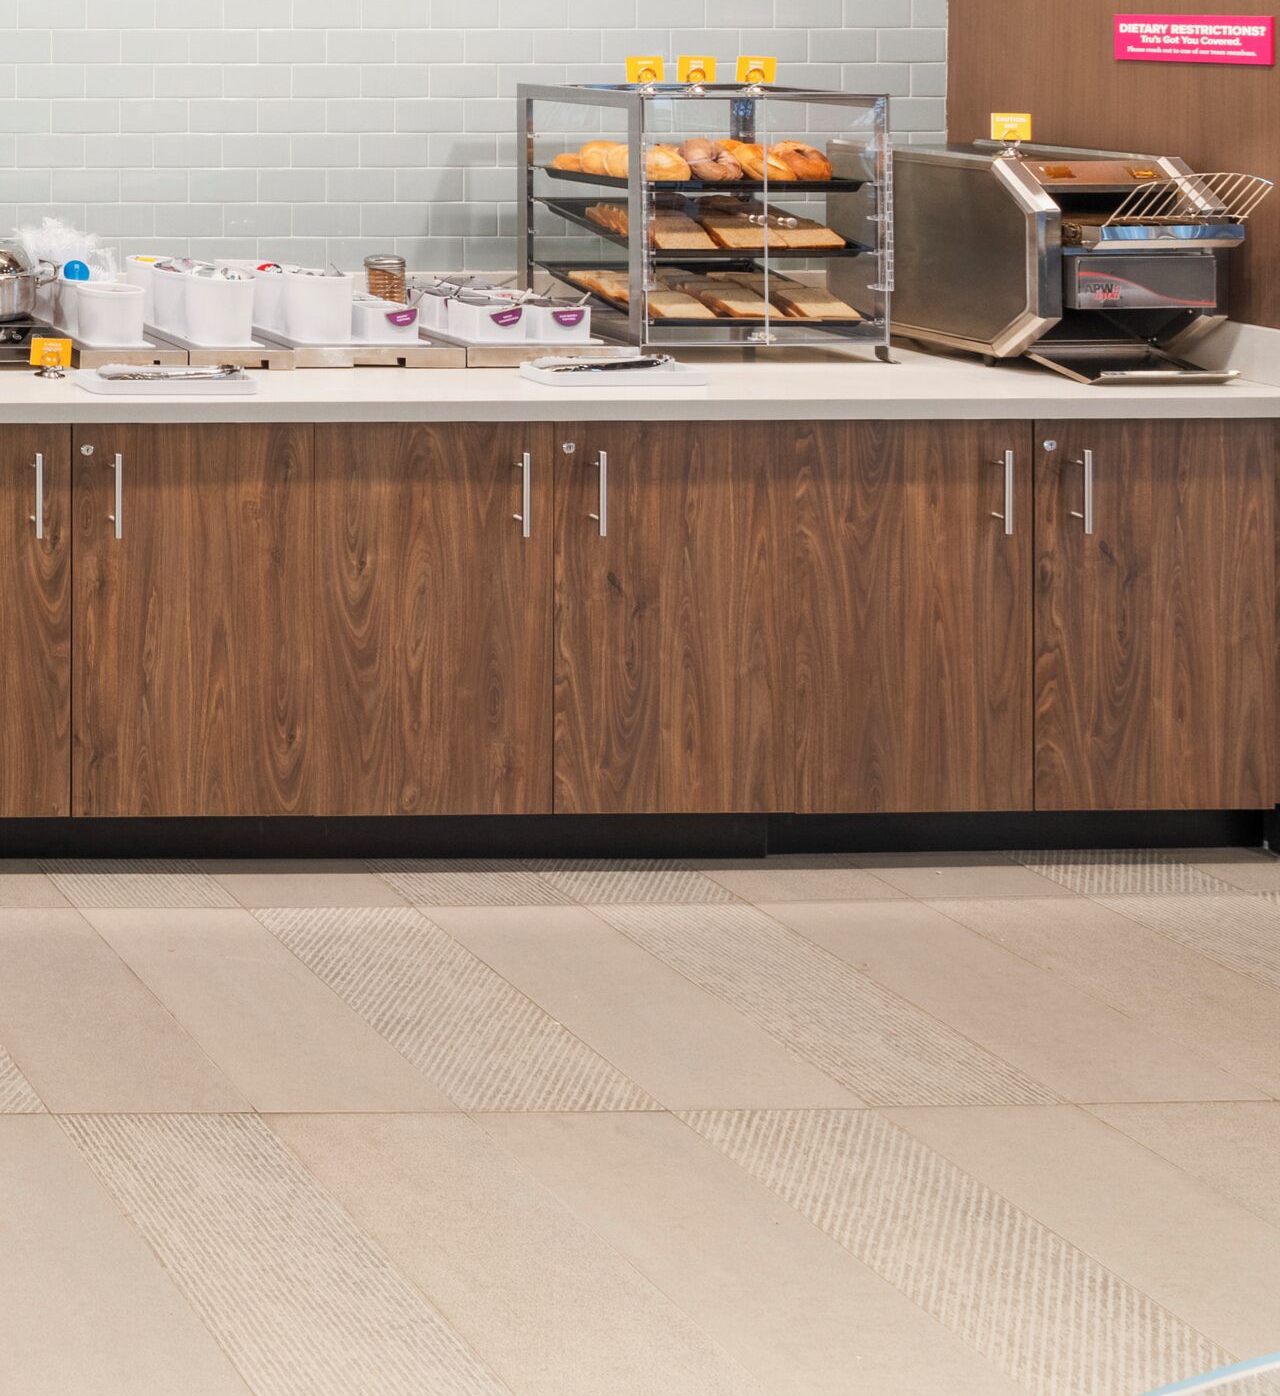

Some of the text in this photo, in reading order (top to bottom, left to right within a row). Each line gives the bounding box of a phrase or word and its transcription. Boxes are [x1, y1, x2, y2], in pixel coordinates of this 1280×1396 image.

[1119, 23, 1266, 36] DIETARY RESTRICTIONS?
[1140, 35, 1242, 46] Tru's Got You Covered.
